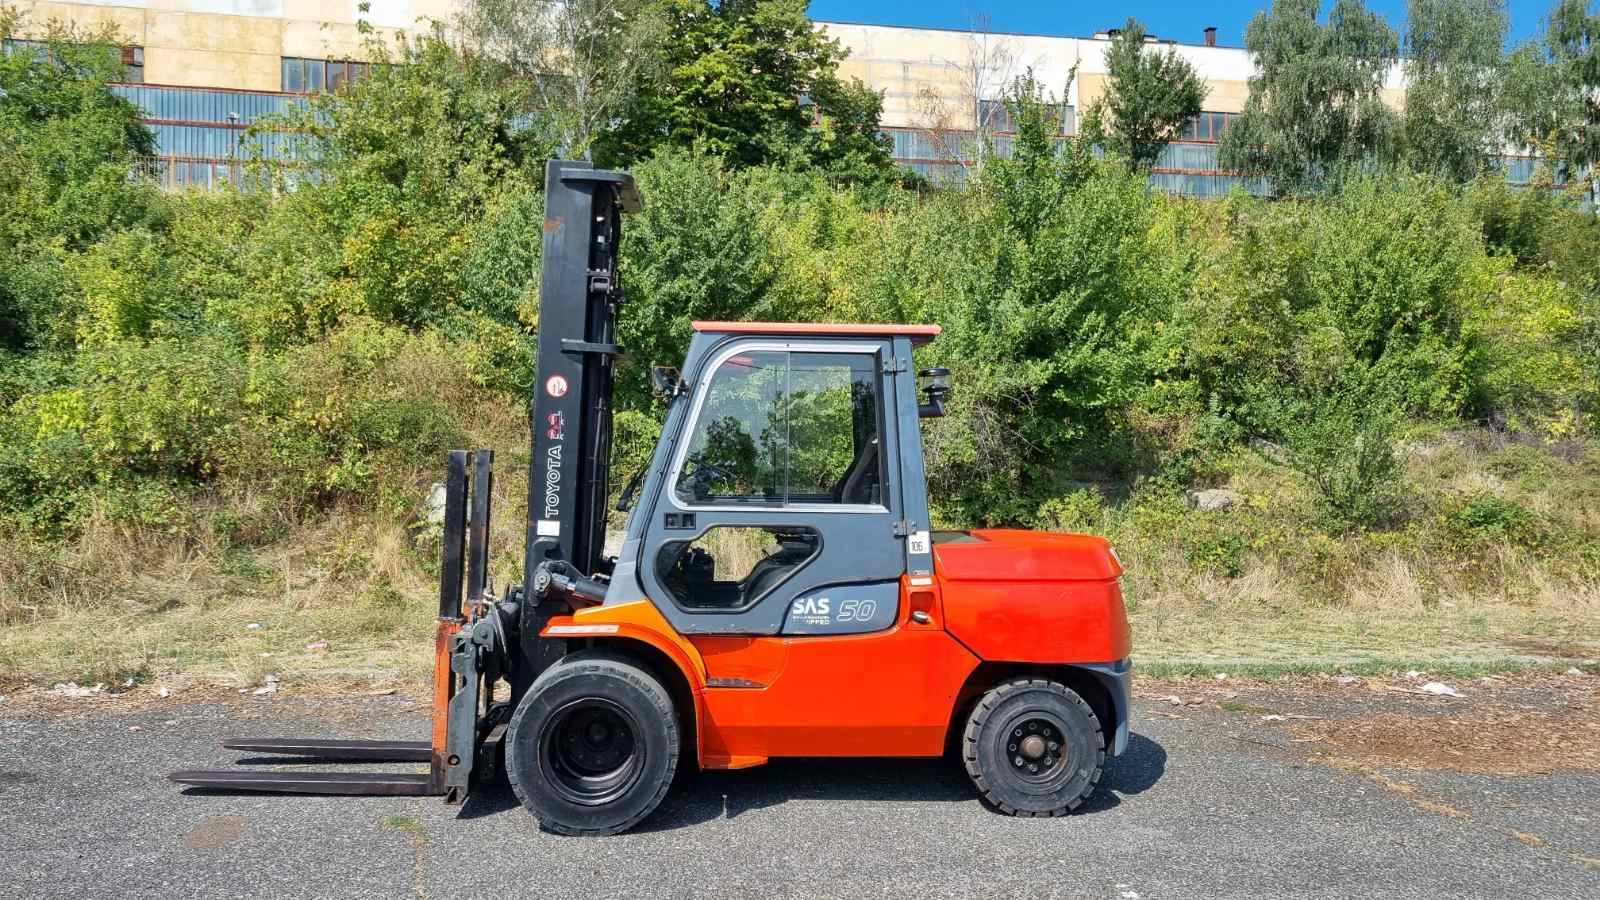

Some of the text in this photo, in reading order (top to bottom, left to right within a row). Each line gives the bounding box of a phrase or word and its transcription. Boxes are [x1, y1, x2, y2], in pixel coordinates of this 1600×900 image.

[545, 445, 562, 518] TOYOTA
[911, 541, 923, 552] 106
[792, 598, 830, 615] SAS
[836, 599, 877, 622] 50
